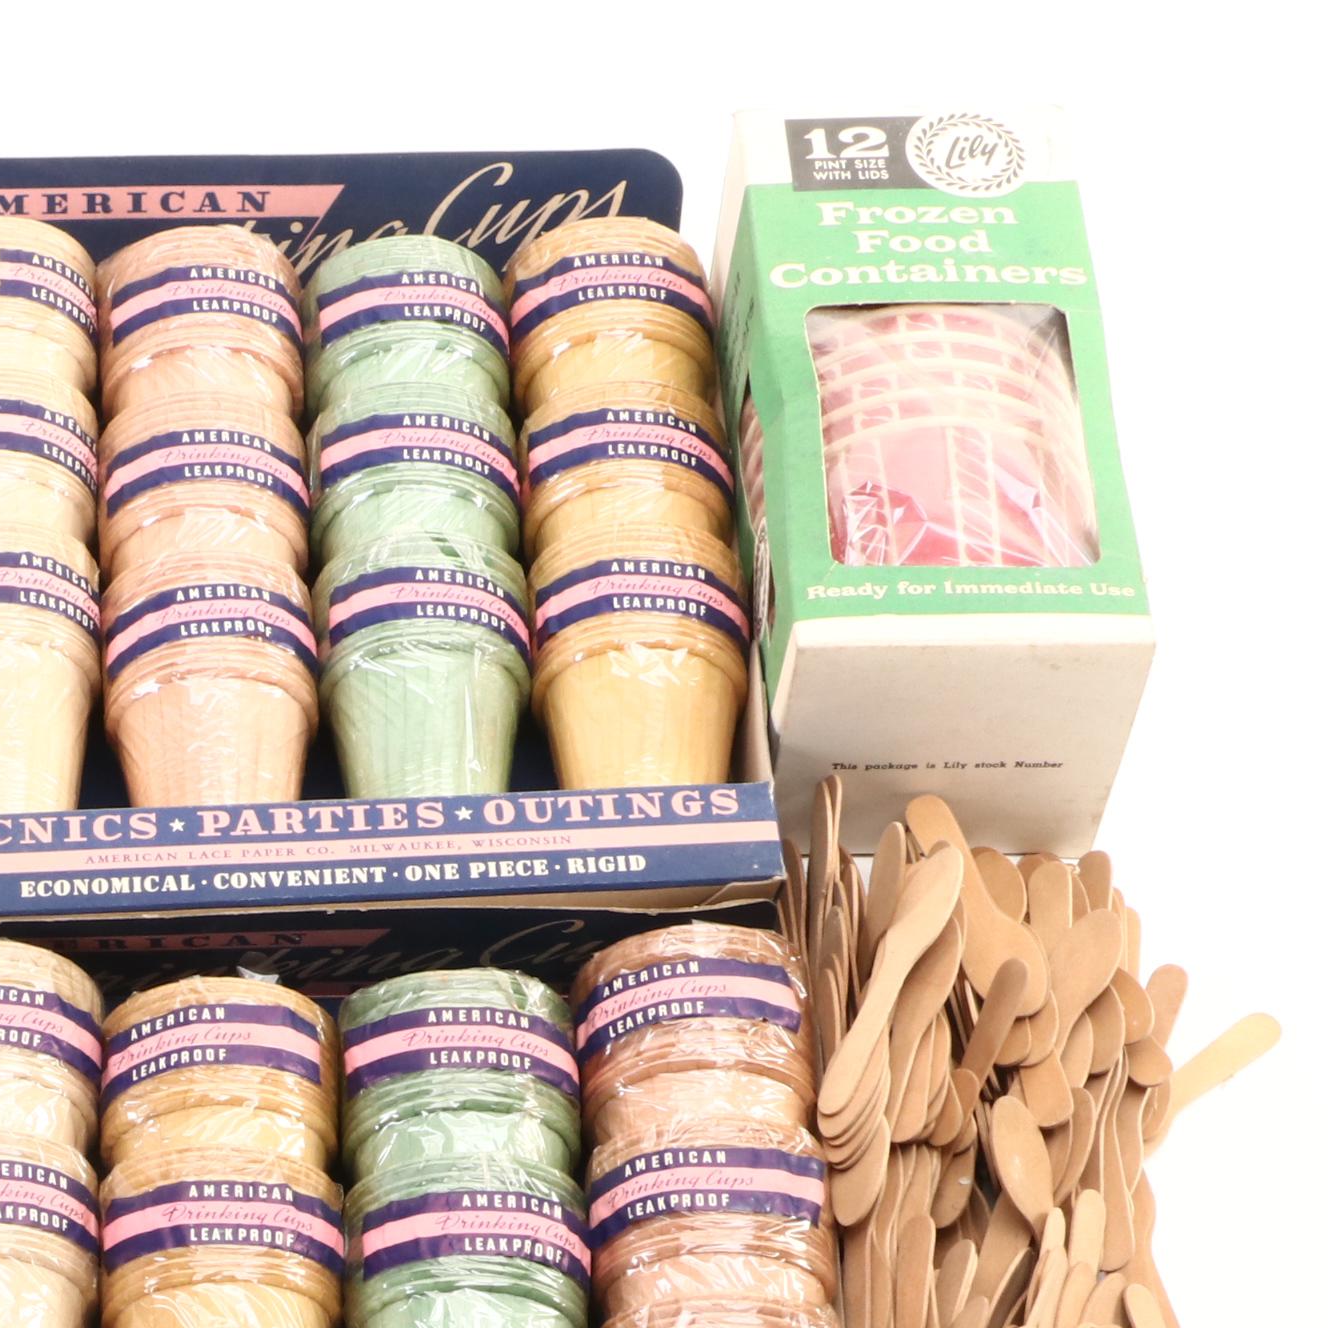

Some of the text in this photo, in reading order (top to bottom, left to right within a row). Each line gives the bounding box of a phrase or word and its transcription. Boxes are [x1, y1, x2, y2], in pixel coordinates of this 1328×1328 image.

[803, 127, 890, 160] 12
[945, 134, 999, 169] Lily
[813, 169, 889, 180] WITH LIDS
[814, 158, 886, 170] PINT SIZE
[818, 201, 1019, 226] Frozen
[855, 229, 992, 254] Food
[574, 255, 663, 266] AMERICAN
[190, 268, 276, 290] AMERICAN
[770, 259, 1088, 288] Containers
[578, 286, 668, 301] LEAKPROOF
[193, 301, 279, 324] LEAKPROOF
[611, 562, 706, 580] AMERICAN
[807, 581, 1135, 600] Ready for Immediate Use
[614, 597, 707, 616] LEAKPROOF
[832, 762, 856, 770] This
[864, 762, 918, 771] package
[943, 761, 966, 770] Lily
[1015, 761, 1063, 769] Number
[197, 801, 445, 838] PARTIES
[483, 789, 740, 825] OUTINGS
[85, 851, 177, 865] AMERICAN
[188, 850, 231, 859] LACE
[242, 848, 294, 858] PAPER
[350, 840, 462, 854] MILWAUKEE,
[472, 834, 572, 846] WISCONSIN
[20, 854, 646, 898] ECONOMICAL CONVENIENT ONE PIECE RIGID
[428, 1010, 529, 1028] AMERICAN
[430, 1051, 532, 1070] LEAKPROOF
[624, 1151, 727, 1177] AMERICAN
[189, 1184, 293, 1202] AMERICAN
[627, 1193, 730, 1219] LEAKPROOF
[190, 1227, 295, 1248] LEAKPROOF
